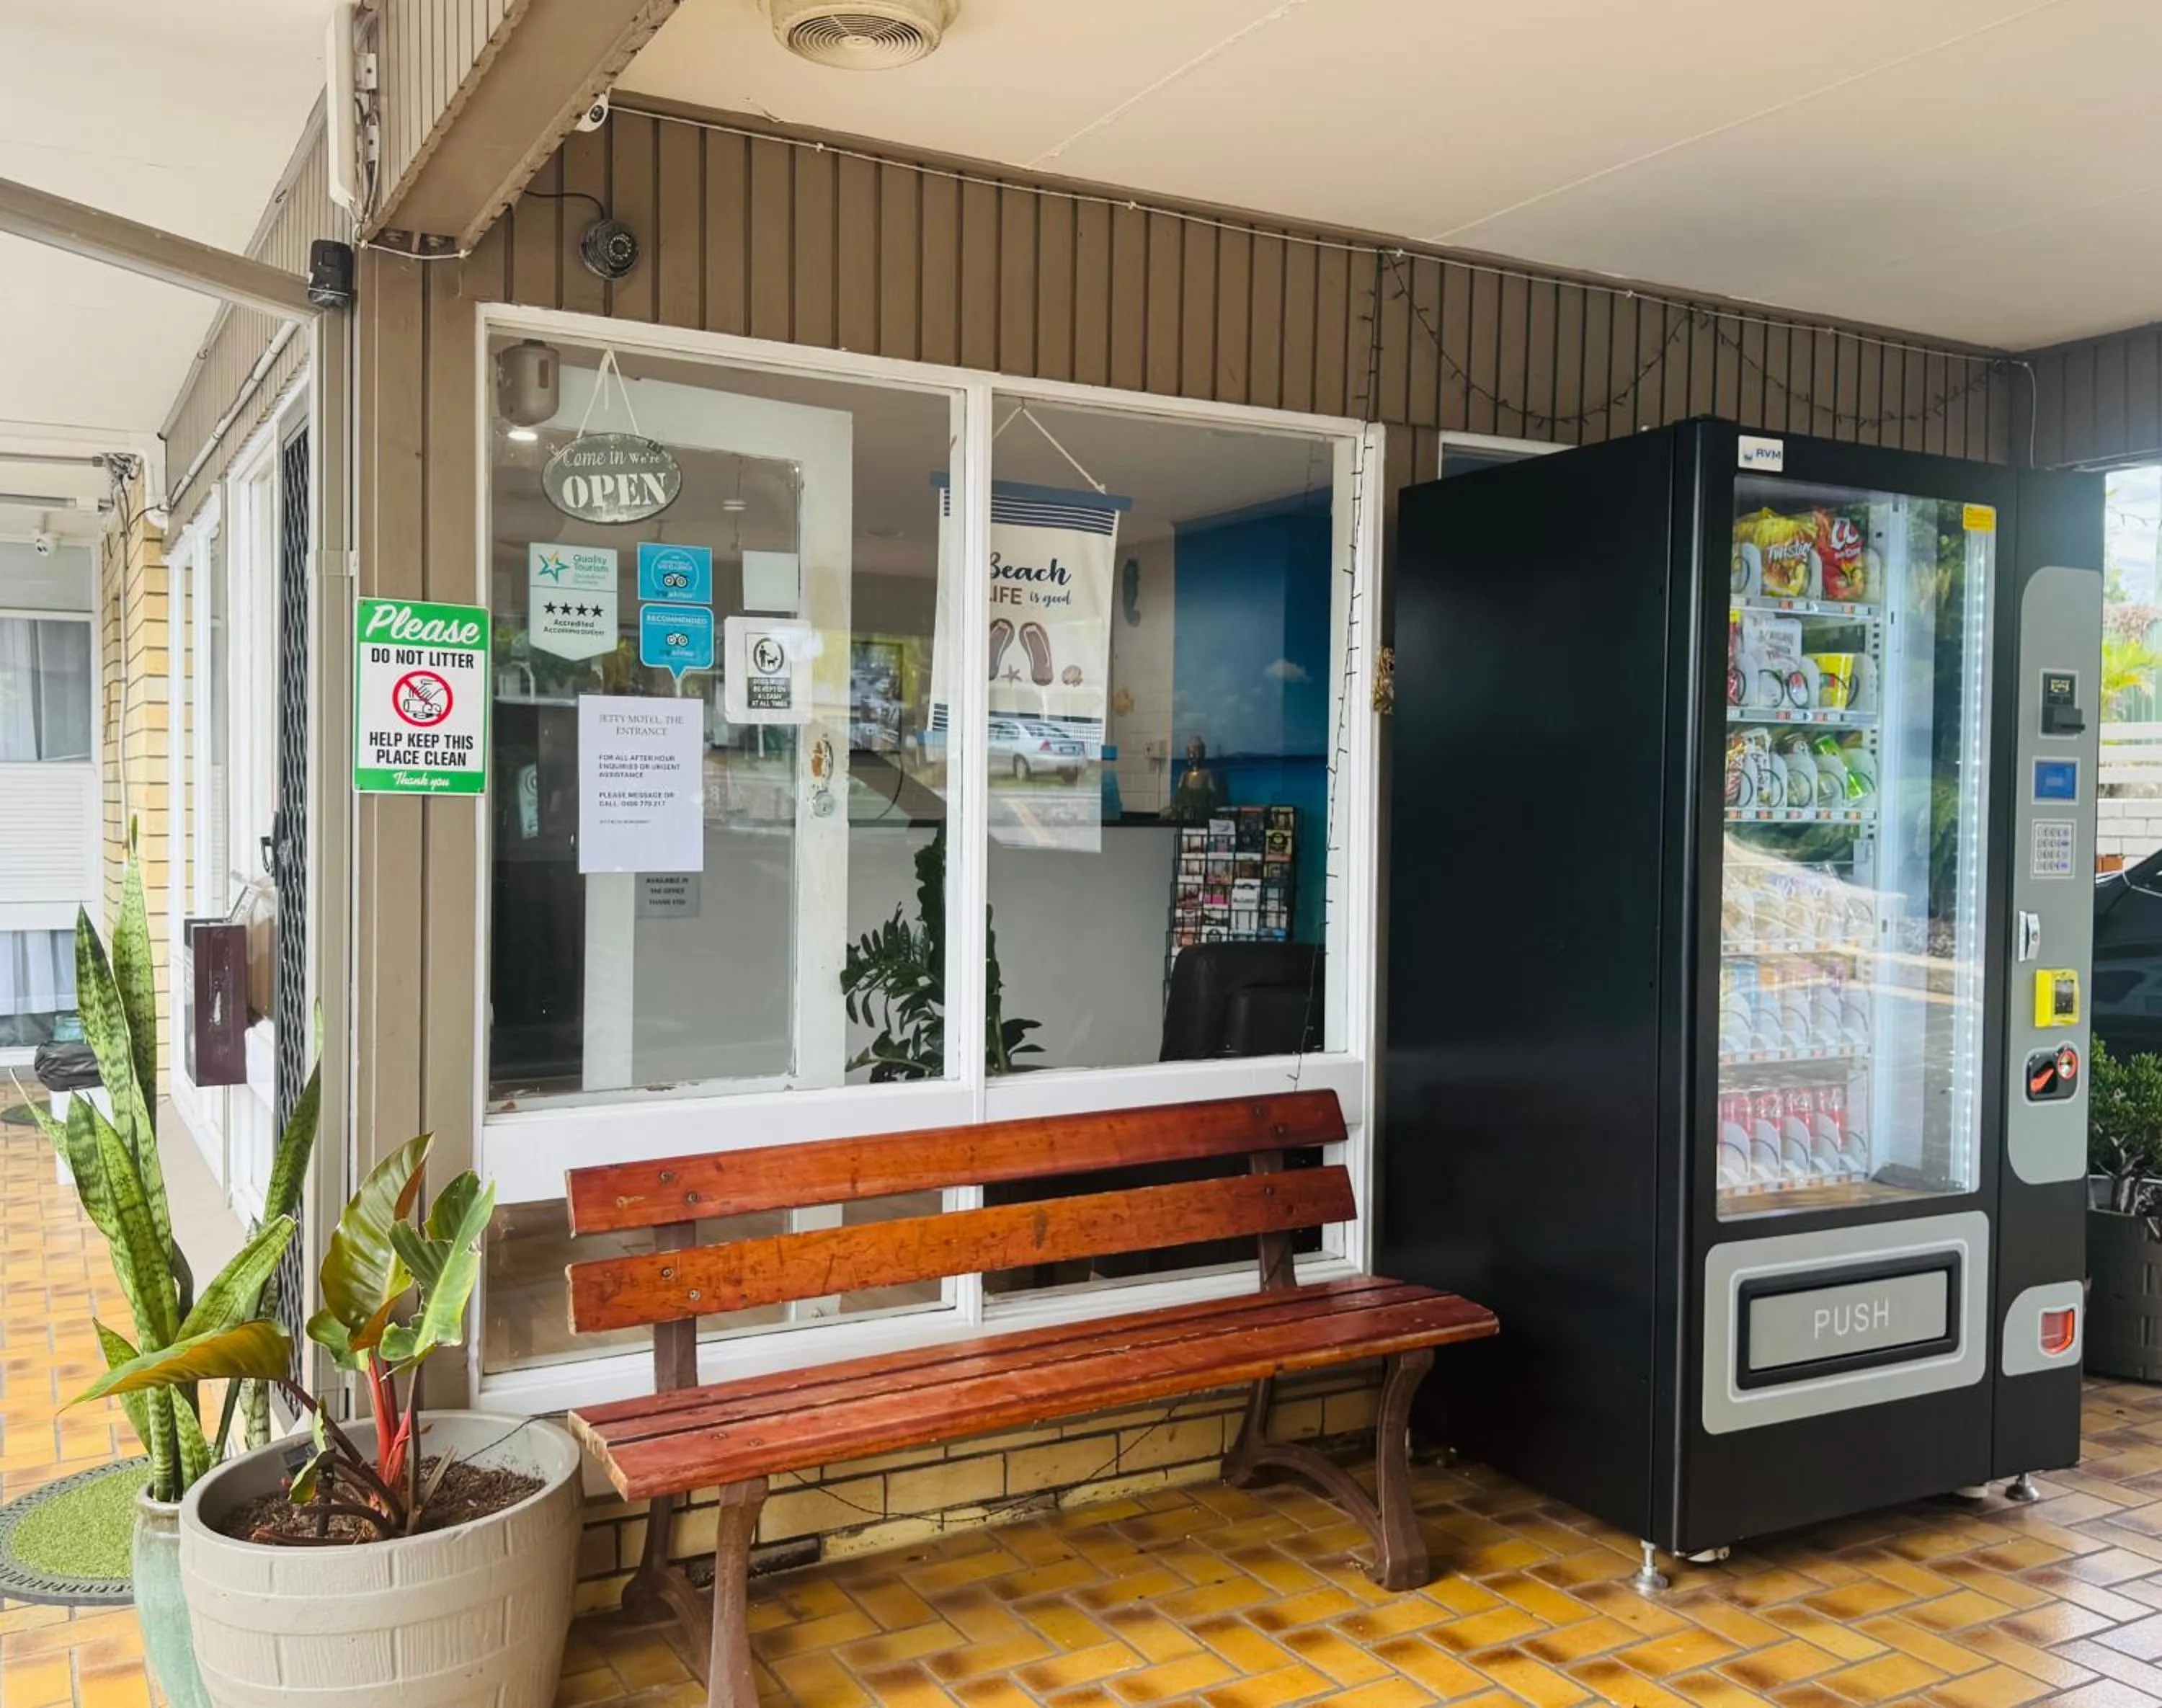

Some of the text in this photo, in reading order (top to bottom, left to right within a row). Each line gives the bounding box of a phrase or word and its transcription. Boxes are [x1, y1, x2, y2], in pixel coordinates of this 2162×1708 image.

[563, 448, 605, 468] Come
[610, 445, 625, 466] in
[1756, 448, 1781, 459] RVM
[562, 473, 666, 508] OPEN
[573, 554, 607, 565] Quality
[574, 564, 608, 572] Tourism
[990, 551, 1071, 585] Beach
[989, 585, 1072, 608] IFE is good
[365, 604, 481, 644] Please
[553, 619, 595, 628] Accredited
[646, 615, 708, 624] RECOMMENDED
[543, 627, 605, 636] Accommodation
[371, 648, 474, 669] DO NOT LITTER
[599, 714, 626, 723] JETTY
[664, 715, 685, 724] THE
[616, 726, 668, 736] ENTRANCE
[370, 731, 473, 750] HELP KEEP THIS
[377, 750, 466, 766] PLACE CLEAN
[393, 770, 450, 791] Thank you
[1814, 1298, 1889, 1339] PUSH
